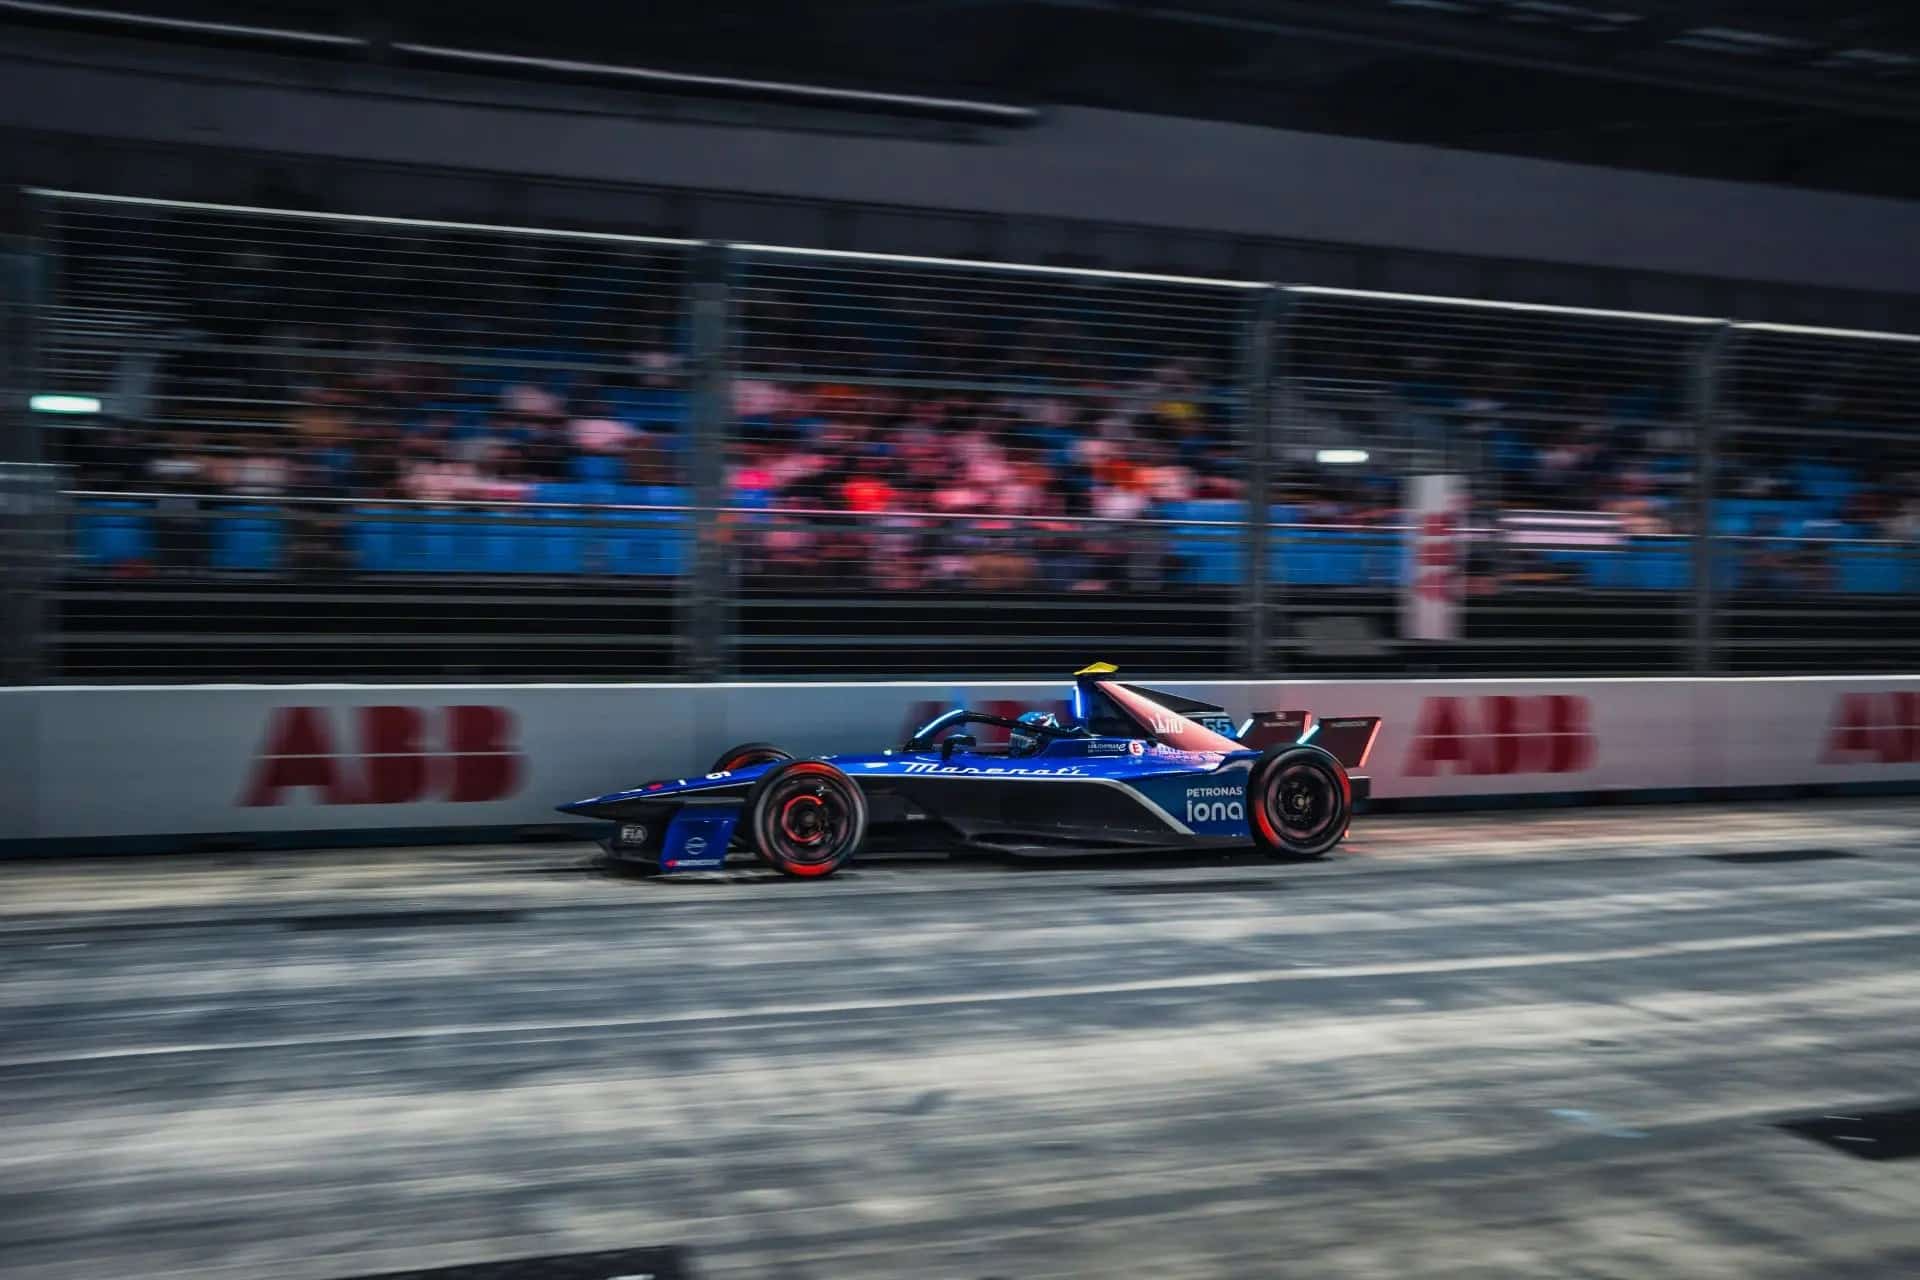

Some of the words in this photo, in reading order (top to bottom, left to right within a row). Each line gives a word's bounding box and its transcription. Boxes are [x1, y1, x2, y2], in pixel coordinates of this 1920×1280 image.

[1404, 695, 1598, 776] ABB
[237, 704, 528, 807] ABB
[900, 761, 1089, 777] Maserati
[1187, 786, 1243, 798] PETRONAS
[1187, 801, 1244, 823] iona
[623, 828, 644, 840] FIA
